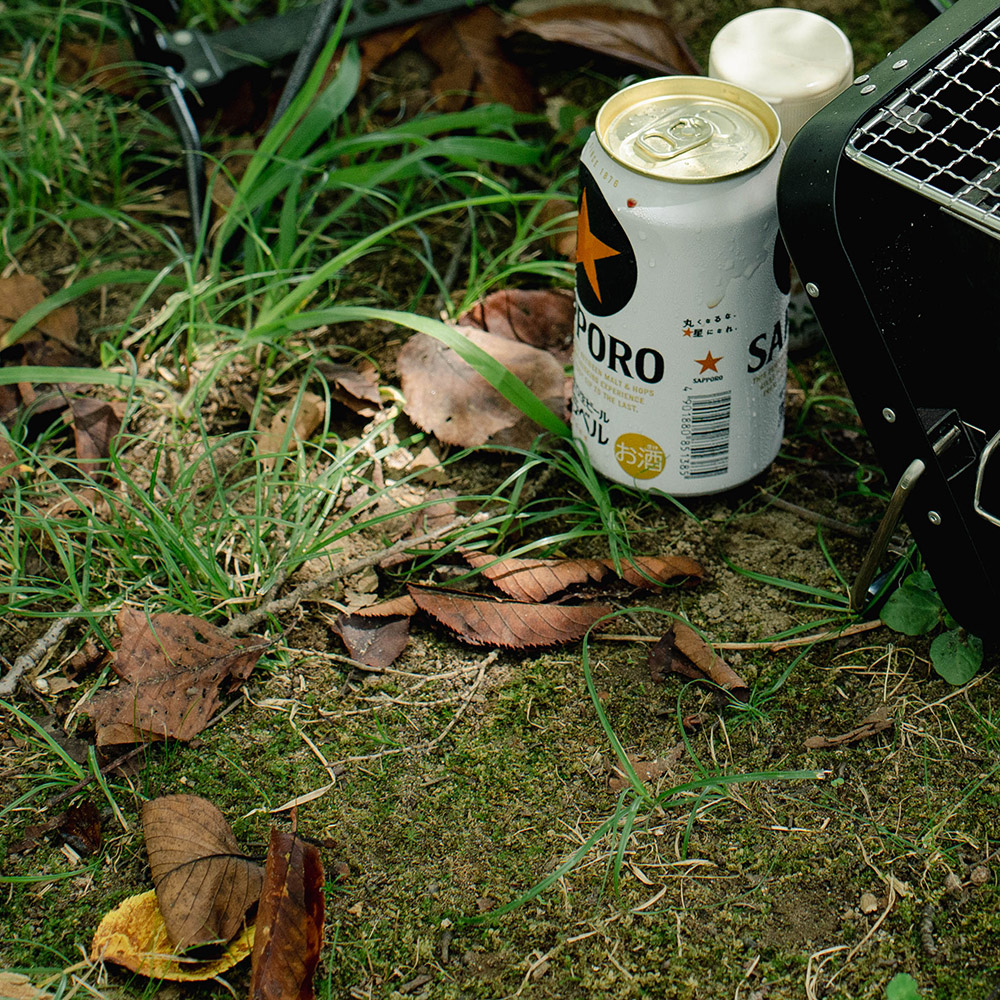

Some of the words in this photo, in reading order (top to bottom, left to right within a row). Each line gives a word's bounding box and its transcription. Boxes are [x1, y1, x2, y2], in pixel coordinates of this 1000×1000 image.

[747, 307, 789, 373] SA
[605, 373, 622, 387] MALT
[624, 383, 631, 392] &
[632, 385, 655, 397] HOPS
[693, 374, 724, 384] SAPPORO
[600, 380, 645, 404] EXPERIENCE
[603, 392, 616, 405] THE
[615, 441, 663, 473] お酒
